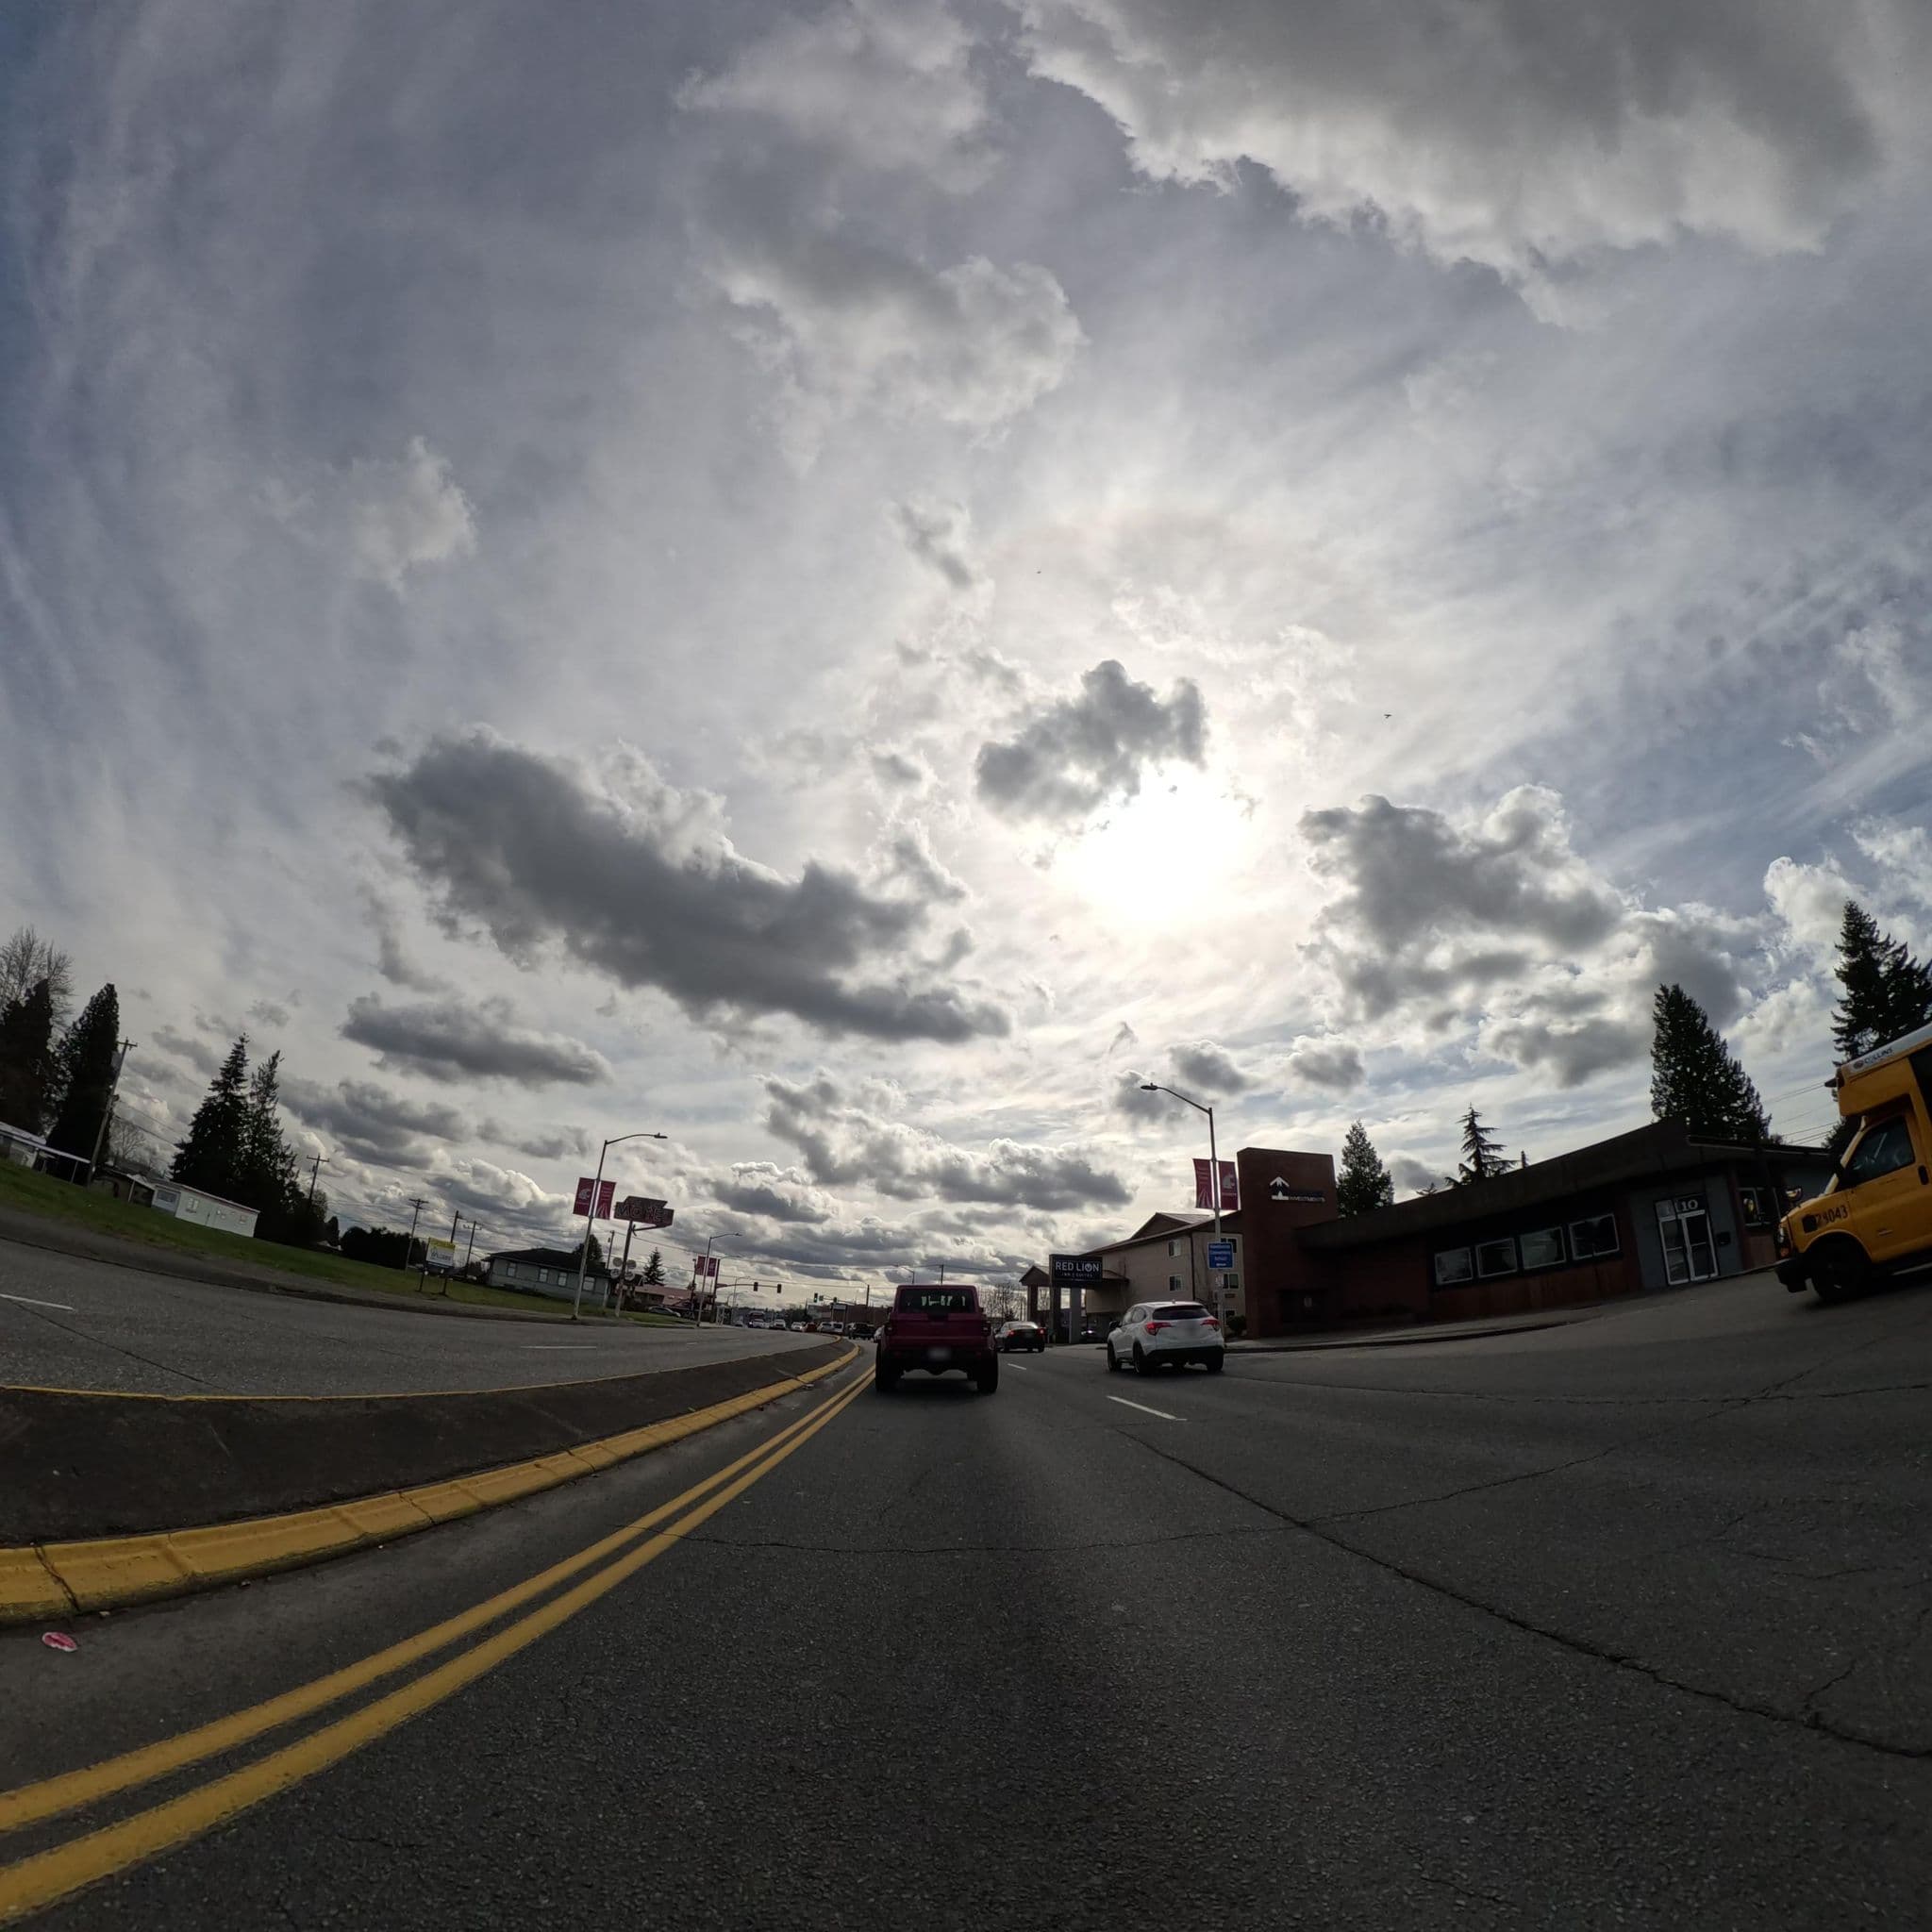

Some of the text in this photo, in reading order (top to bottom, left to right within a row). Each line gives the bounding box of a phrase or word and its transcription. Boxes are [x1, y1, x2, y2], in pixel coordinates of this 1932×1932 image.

[1681, 1199, 1698, 1211] 10
[1055, 1261, 1099, 1273] RED LION
